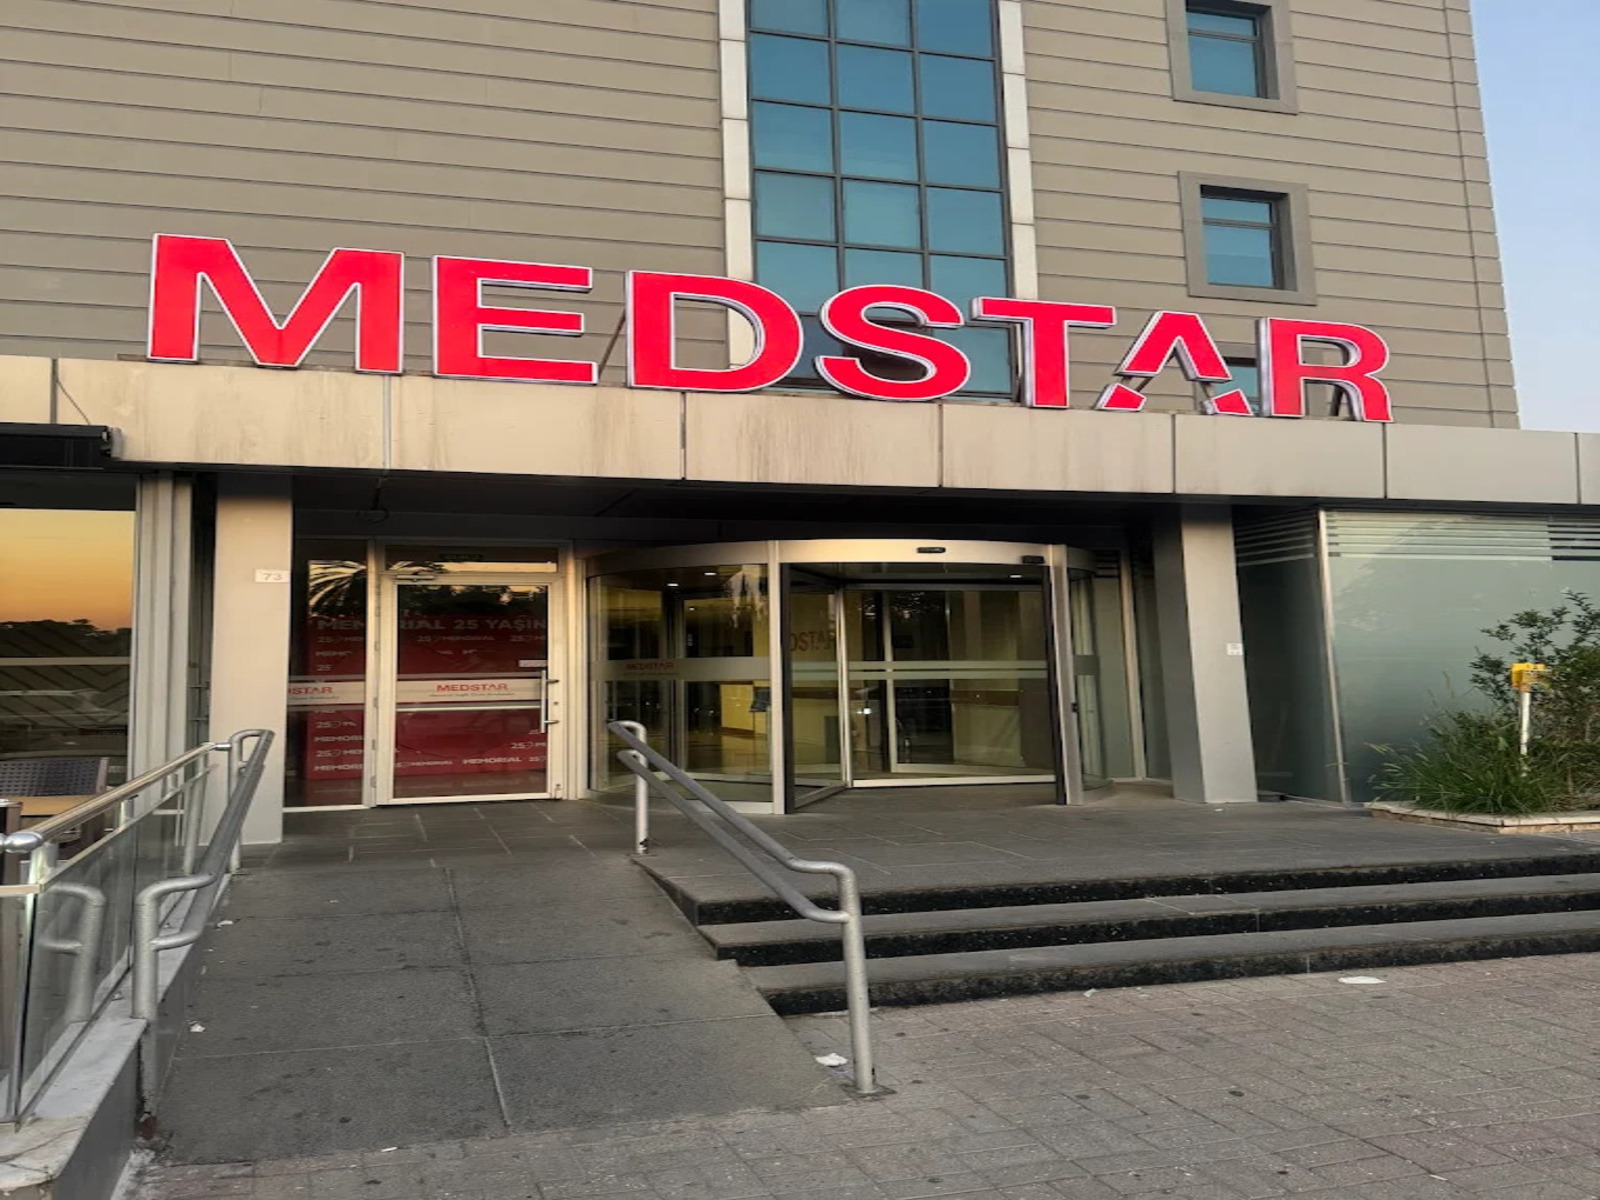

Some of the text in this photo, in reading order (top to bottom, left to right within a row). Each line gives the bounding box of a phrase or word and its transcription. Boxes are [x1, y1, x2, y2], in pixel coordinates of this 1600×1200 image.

[146, 232, 1394, 423] MEDSTAR
[262, 572, 283, 581] 73
[453, 619, 479, 630] 25
[436, 683, 508, 692] MEDSTAR
[462, 756, 522, 765] MEMORIAL
